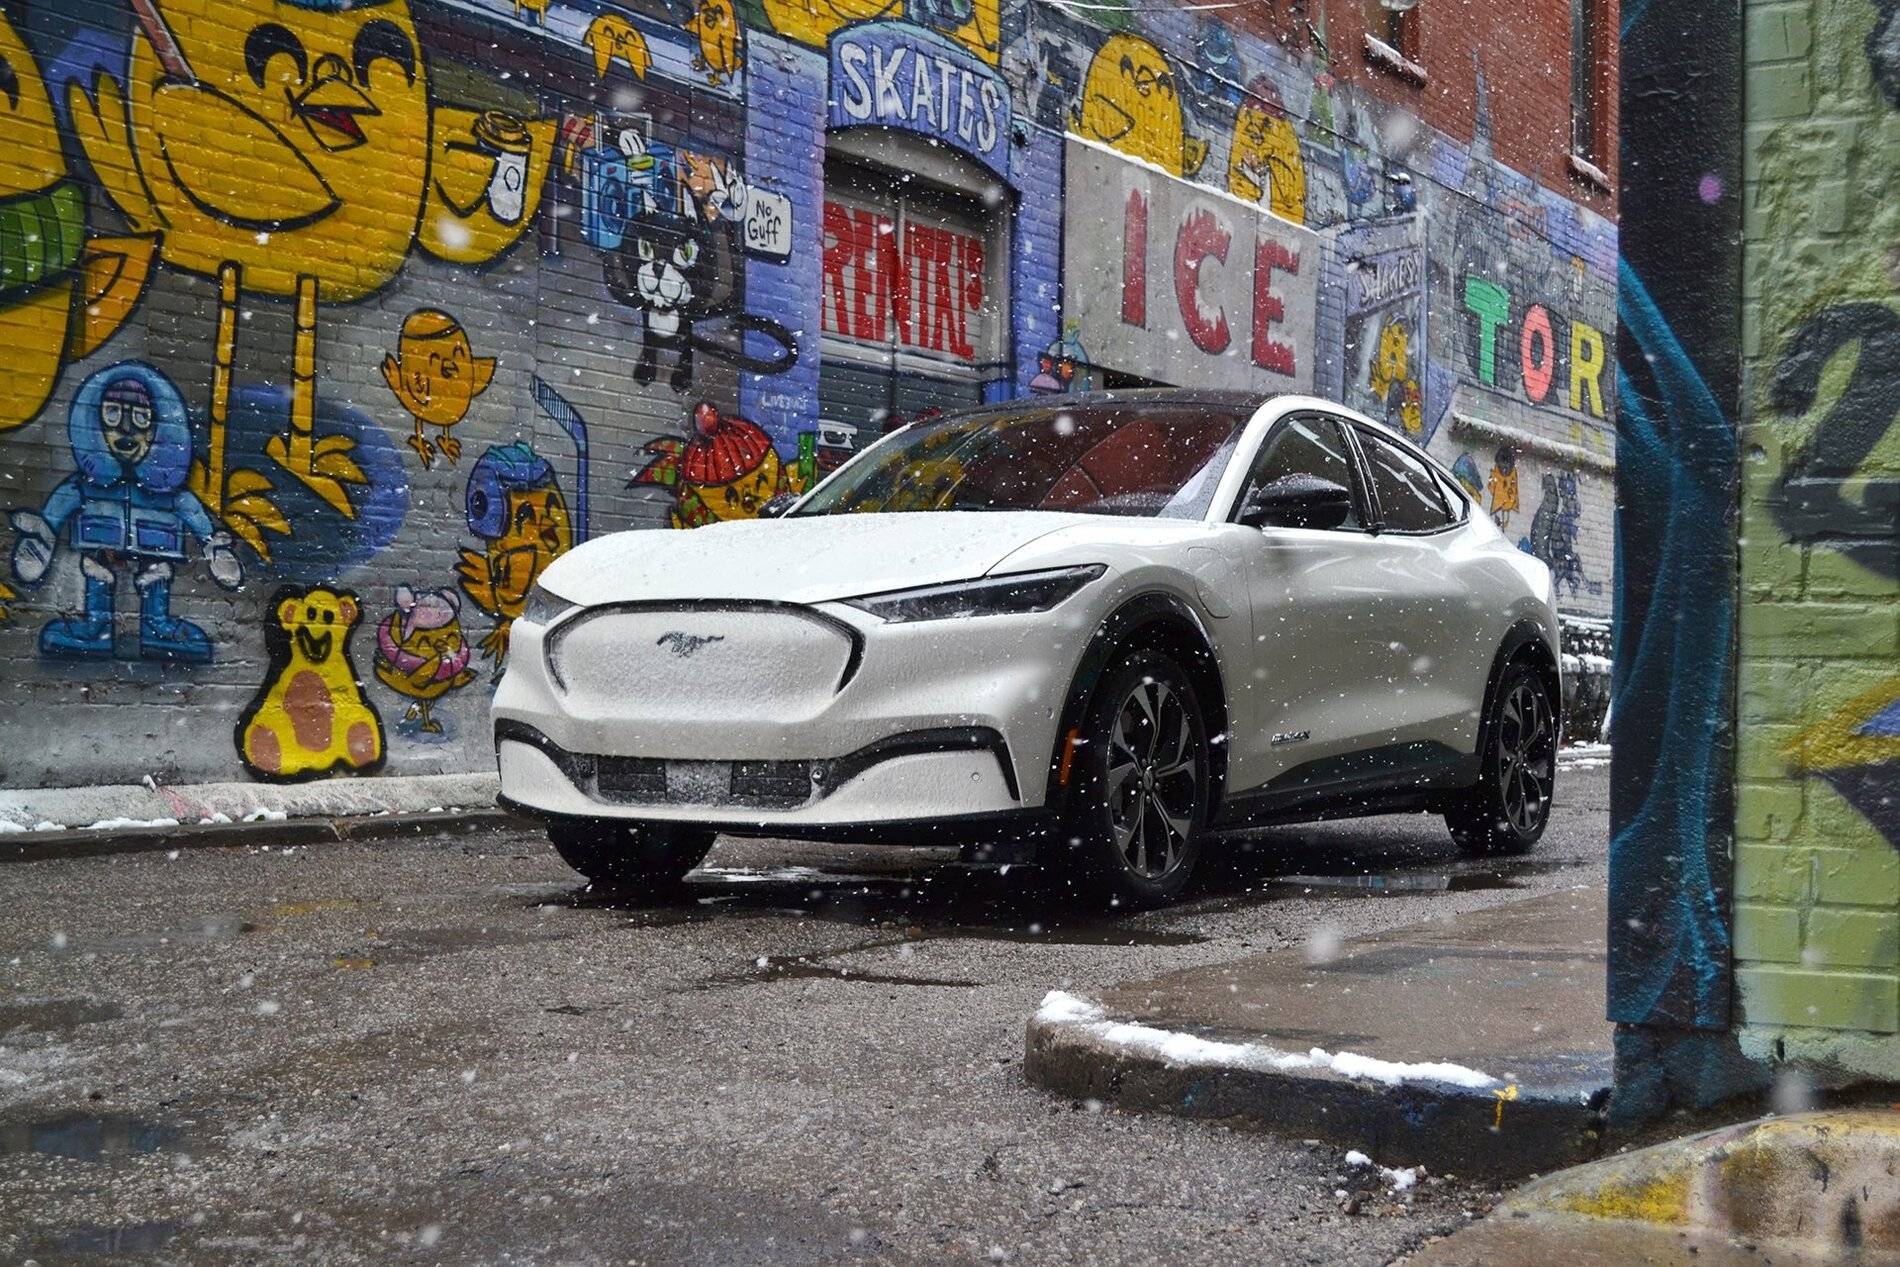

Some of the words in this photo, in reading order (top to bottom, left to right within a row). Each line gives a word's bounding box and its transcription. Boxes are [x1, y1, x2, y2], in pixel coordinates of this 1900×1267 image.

[840, 42, 1001, 153] SKATES
[747, 215, 782, 245] Guff
[755, 200, 773, 218] No
[1121, 172, 1301, 379] ICE
[1465, 273, 1606, 418] TOR
